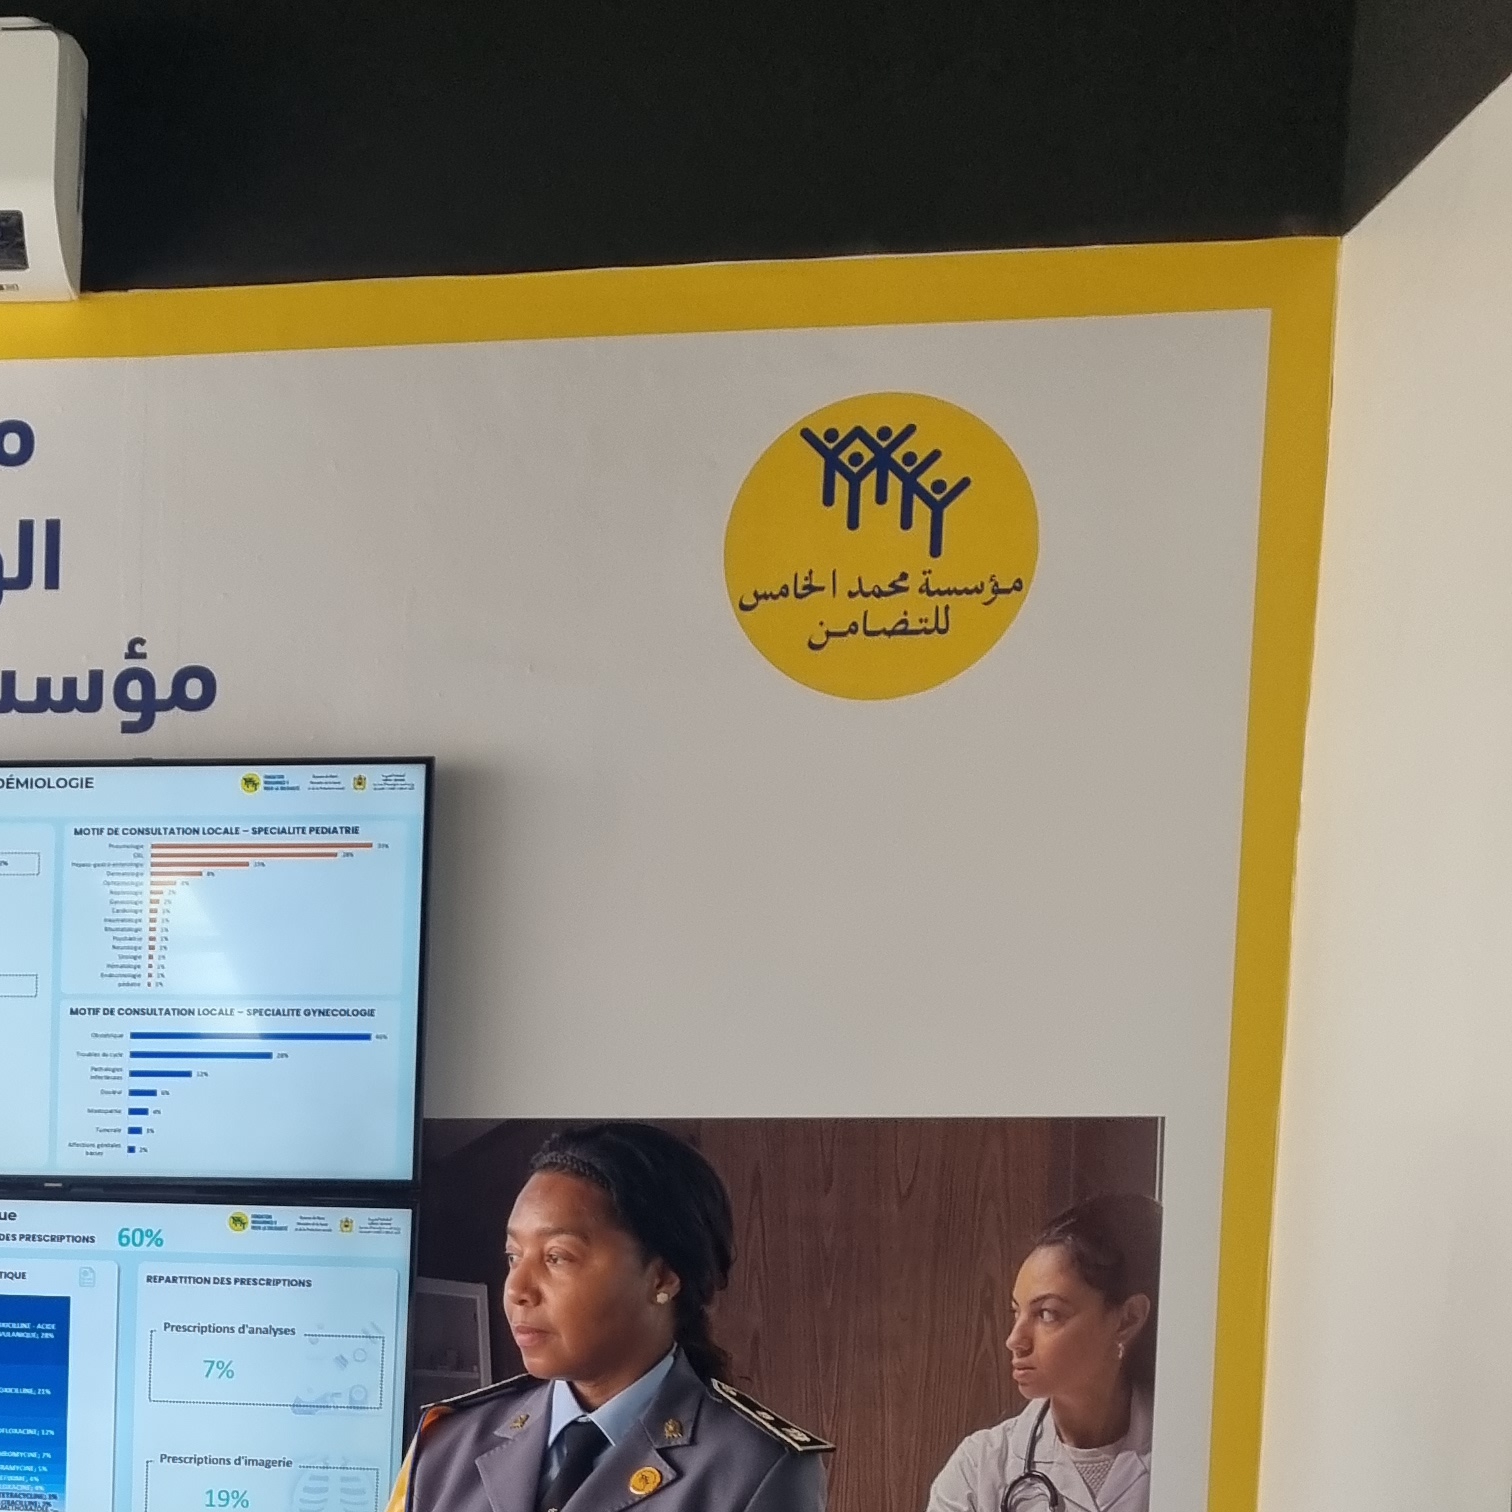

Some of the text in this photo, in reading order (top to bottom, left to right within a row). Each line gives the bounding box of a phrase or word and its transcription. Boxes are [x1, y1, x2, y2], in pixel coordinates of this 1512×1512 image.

[738, 568, 1024, 612] مؤسسة محمد الخامس
[807, 603, 951, 651] للتضامن
[73, 826, 360, 836] MOTIF DE CONSULTATION LOCALE SPECIALITE PEDIATRIE
[69, 1007, 376, 1018] MOTIF DE CONSULTATION LOCALE SPECIALITE GYNECOLOGIE
[19, 1233, 96, 1244] PRESCRIPTIONS
[117, 1227, 165, 1248] 60%
[146, 1275, 312, 1289] REPARTITION DES PRESCRIPTIONS
[163, 1321, 297, 1338] Prescriptions d'analyses
[203, 1359, 236, 1380] 7%
[159, 1452, 294, 1470] Prescriptions d'imagerie
[204, 1488, 250, 1510] 19%
